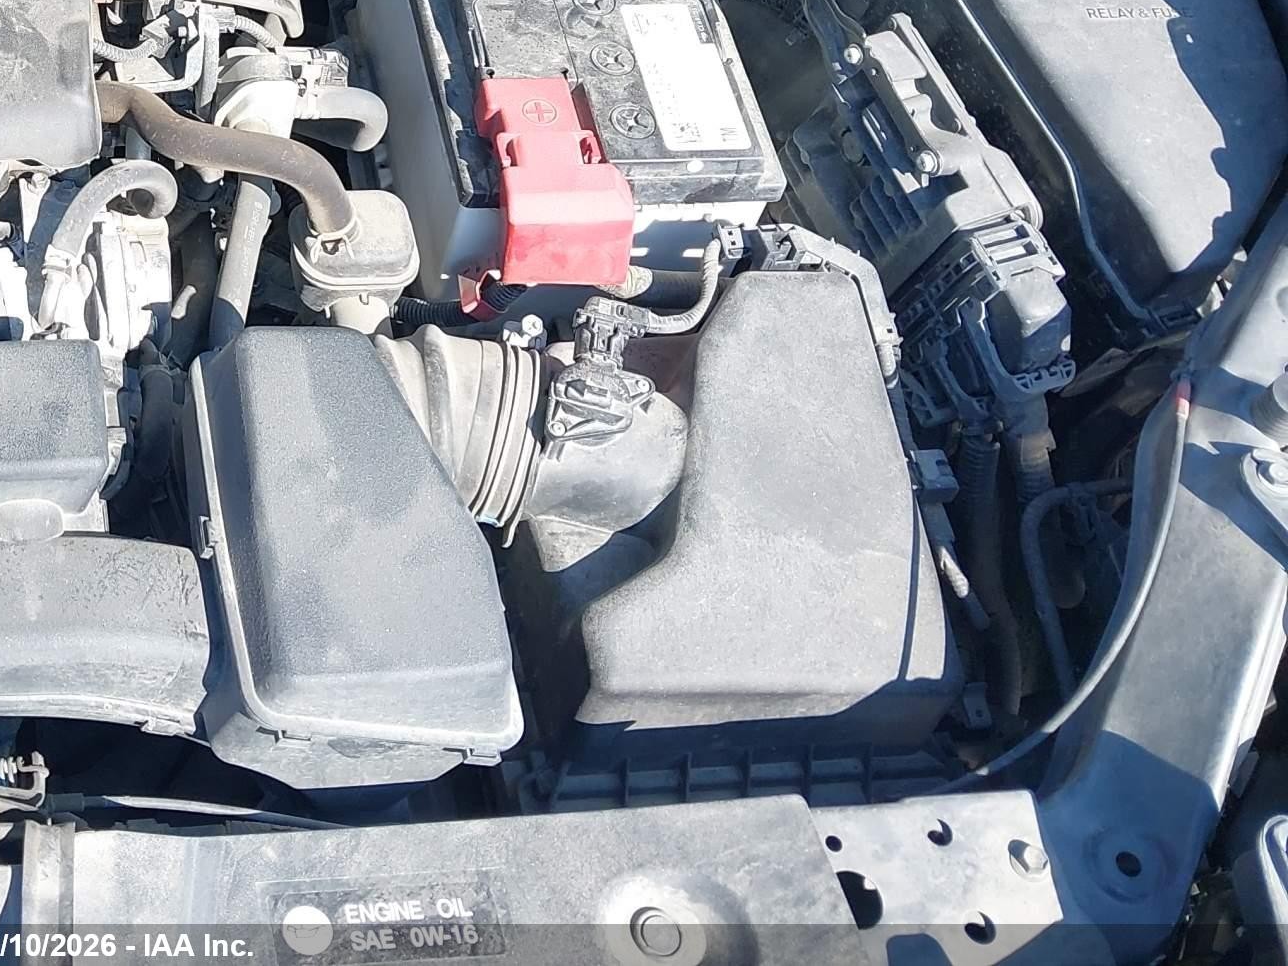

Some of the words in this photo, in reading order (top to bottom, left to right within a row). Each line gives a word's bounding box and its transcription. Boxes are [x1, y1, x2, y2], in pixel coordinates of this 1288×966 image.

[1086, 8, 1134, 19] RELAY
[1138, 8, 1149, 19] &
[344, 899, 425, 924] ENGINE
[435, 897, 474, 919] OIL
[350, 928, 397, 952] SAE
[409, 923, 480, 948] 0W-16
